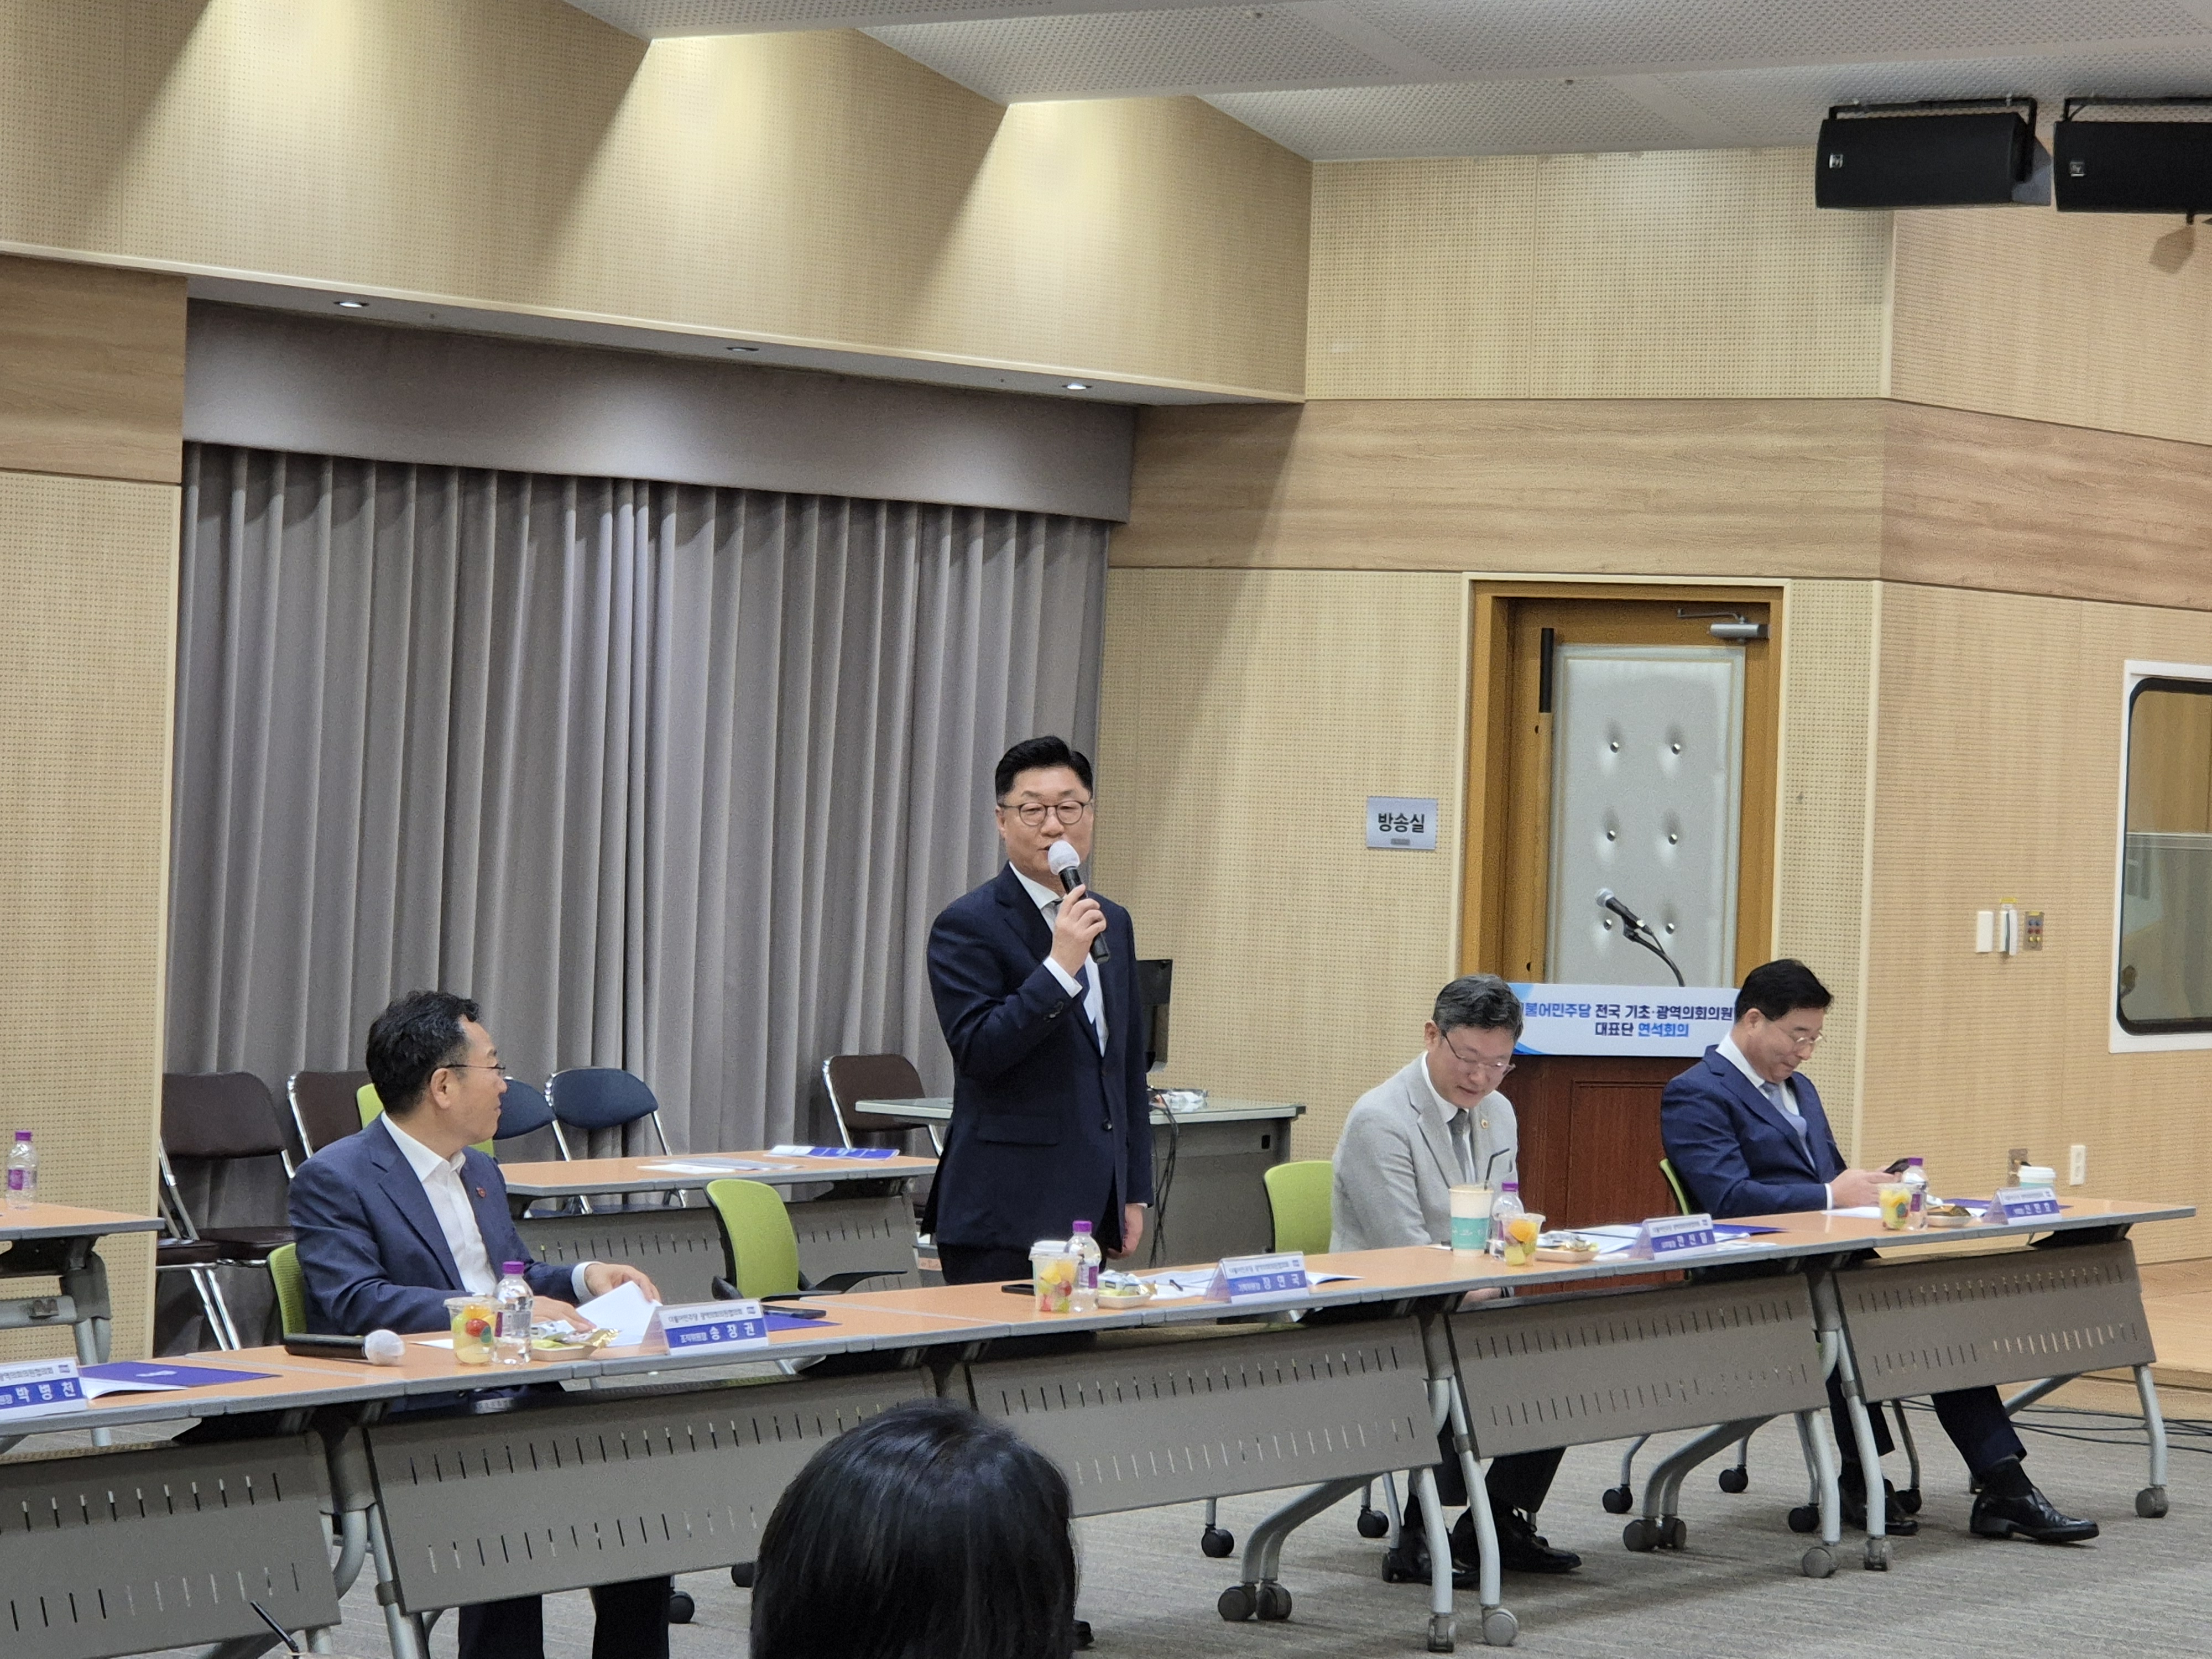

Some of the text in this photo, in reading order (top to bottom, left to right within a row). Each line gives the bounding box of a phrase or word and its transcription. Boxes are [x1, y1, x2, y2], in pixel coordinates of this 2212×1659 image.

[1378, 813, 1425, 833] 방송실
[1521, 1002, 1592, 1018] 불어민주당
[1595, 1004, 1621, 1019] 전국
[1595, 1022, 1689, 1037] 대표단 연석회의
